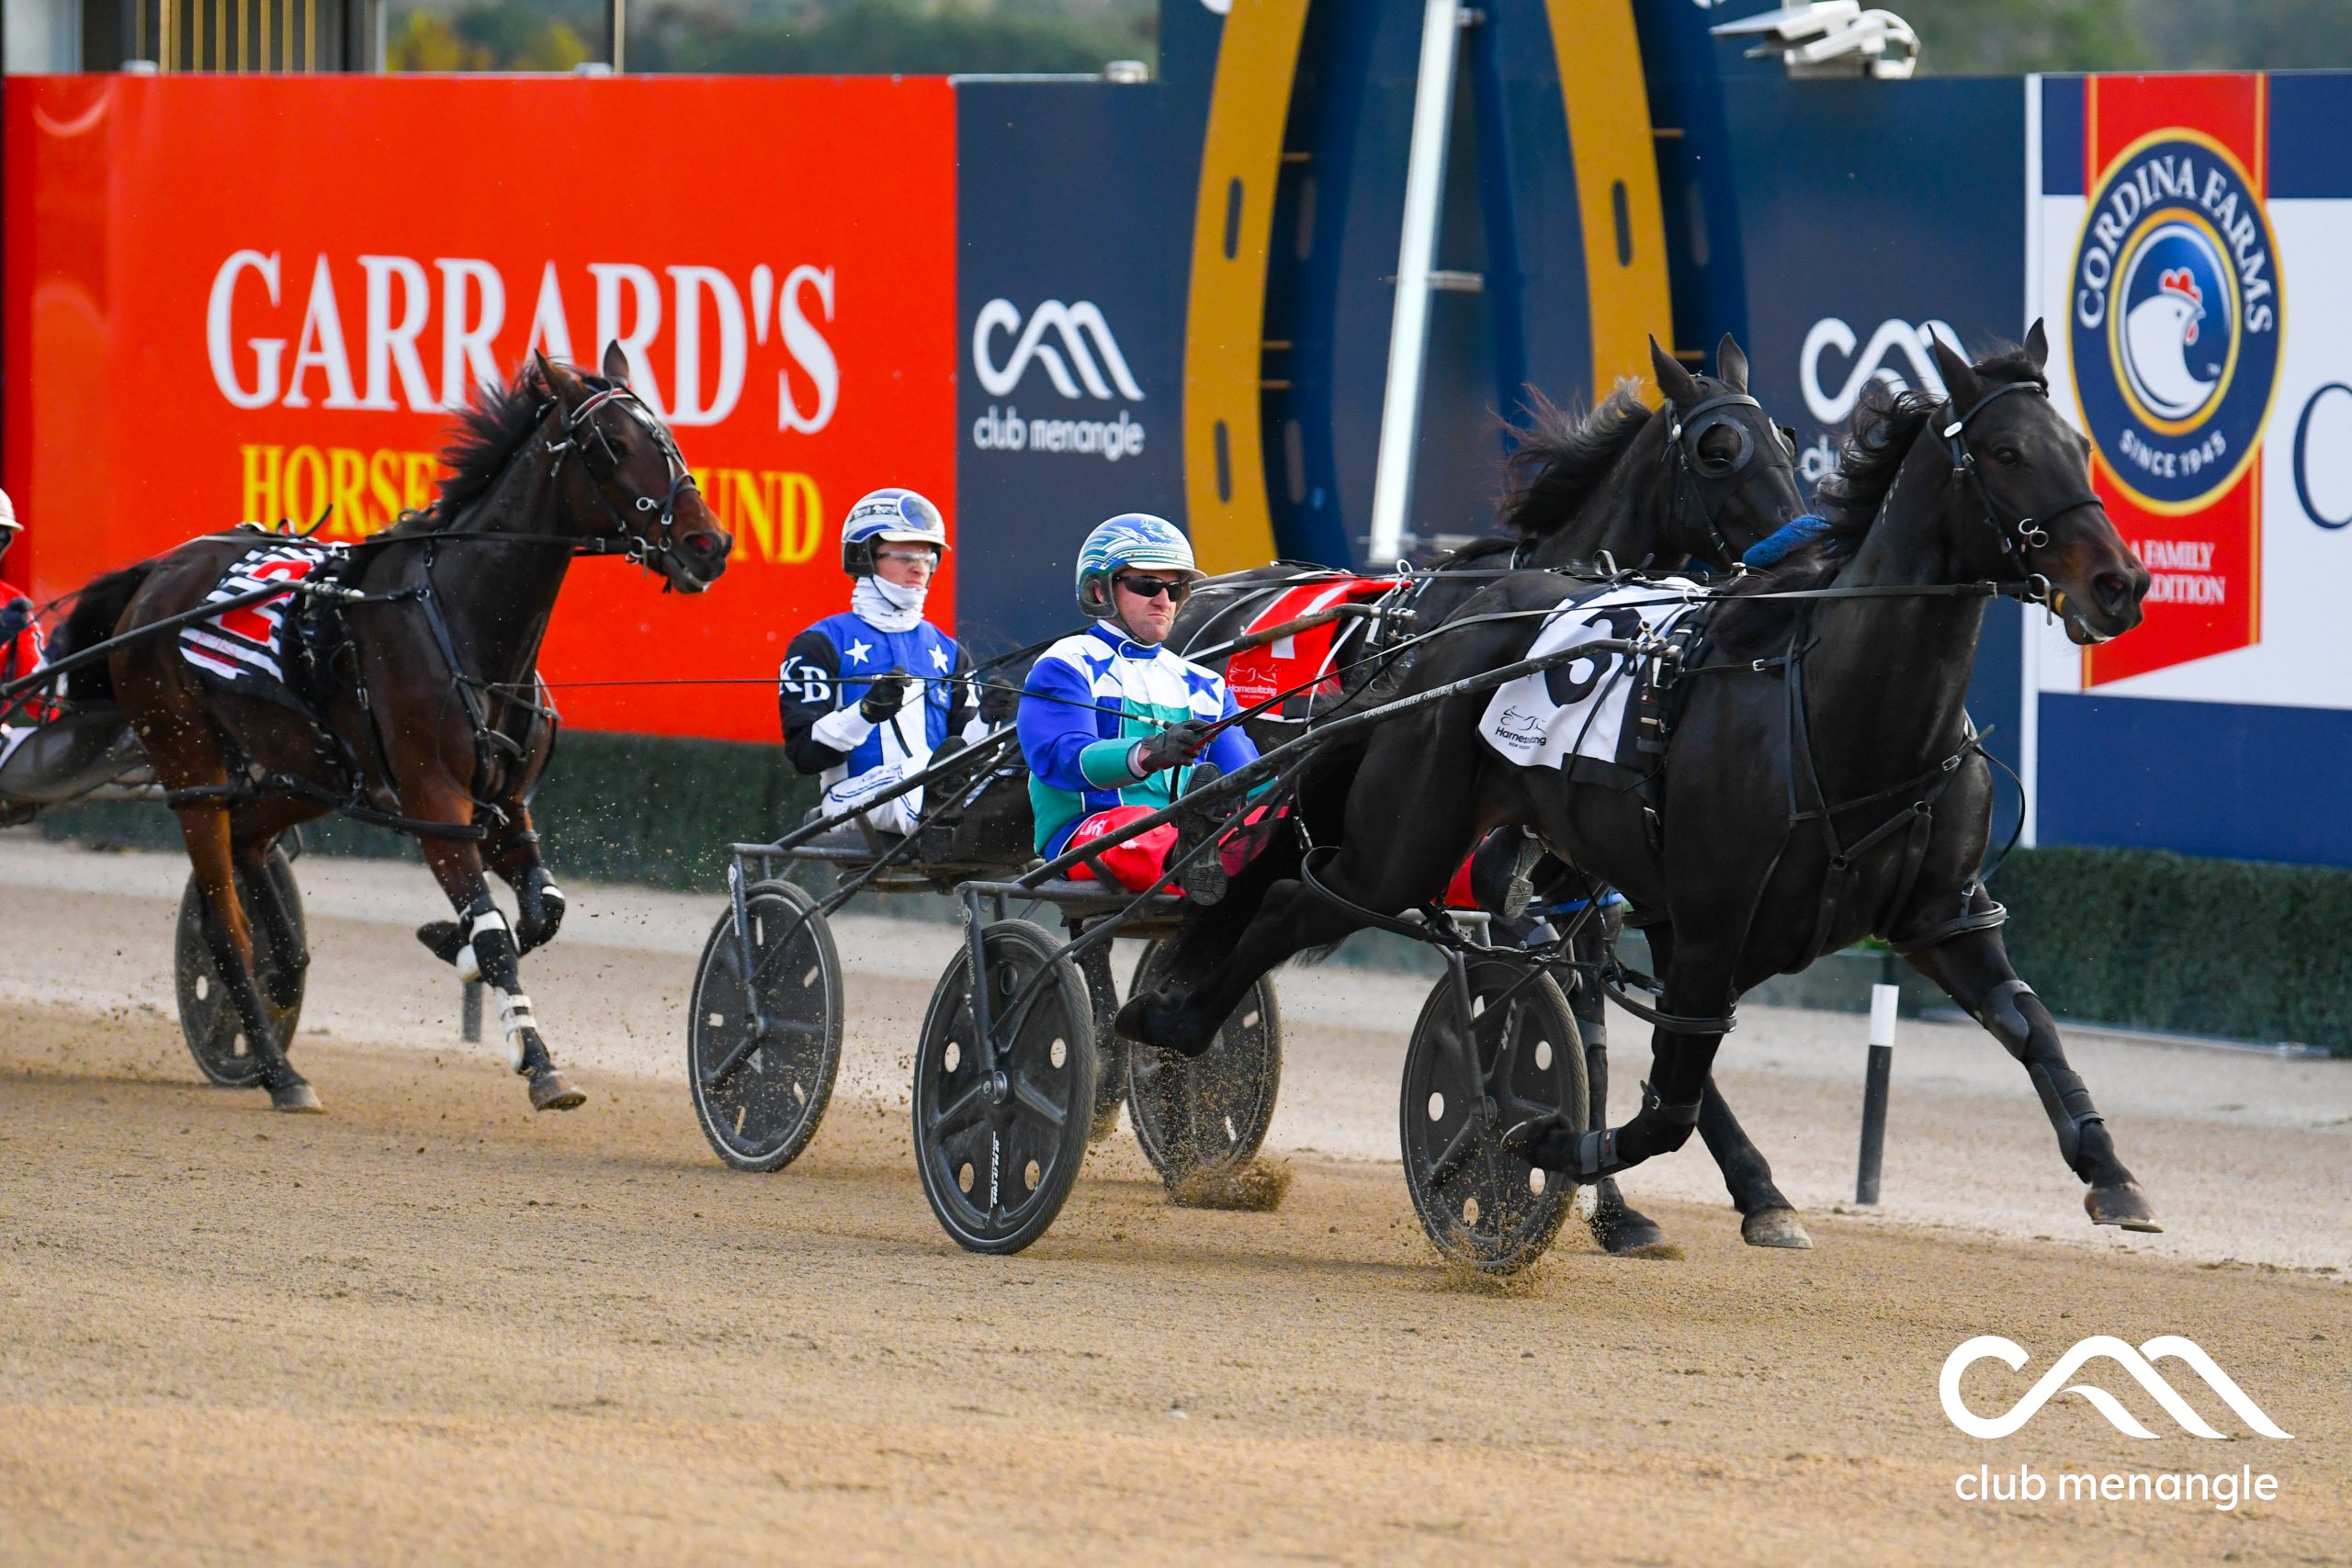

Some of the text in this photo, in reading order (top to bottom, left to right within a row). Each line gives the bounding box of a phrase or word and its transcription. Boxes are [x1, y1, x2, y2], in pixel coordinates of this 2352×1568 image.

[2077, 155, 2272, 333] CORDINA FARMS
[206, 249, 840, 434] GARRARD'S
[973, 404, 1146, 462] club menangle
[2119, 429, 2177, 478] SINCE
[240, 445, 438, 538] HORSE
[2144, 540, 2215, 570] FAMILY
[2149, 573, 2226, 604] DITION
[778, 656, 831, 704] KB
